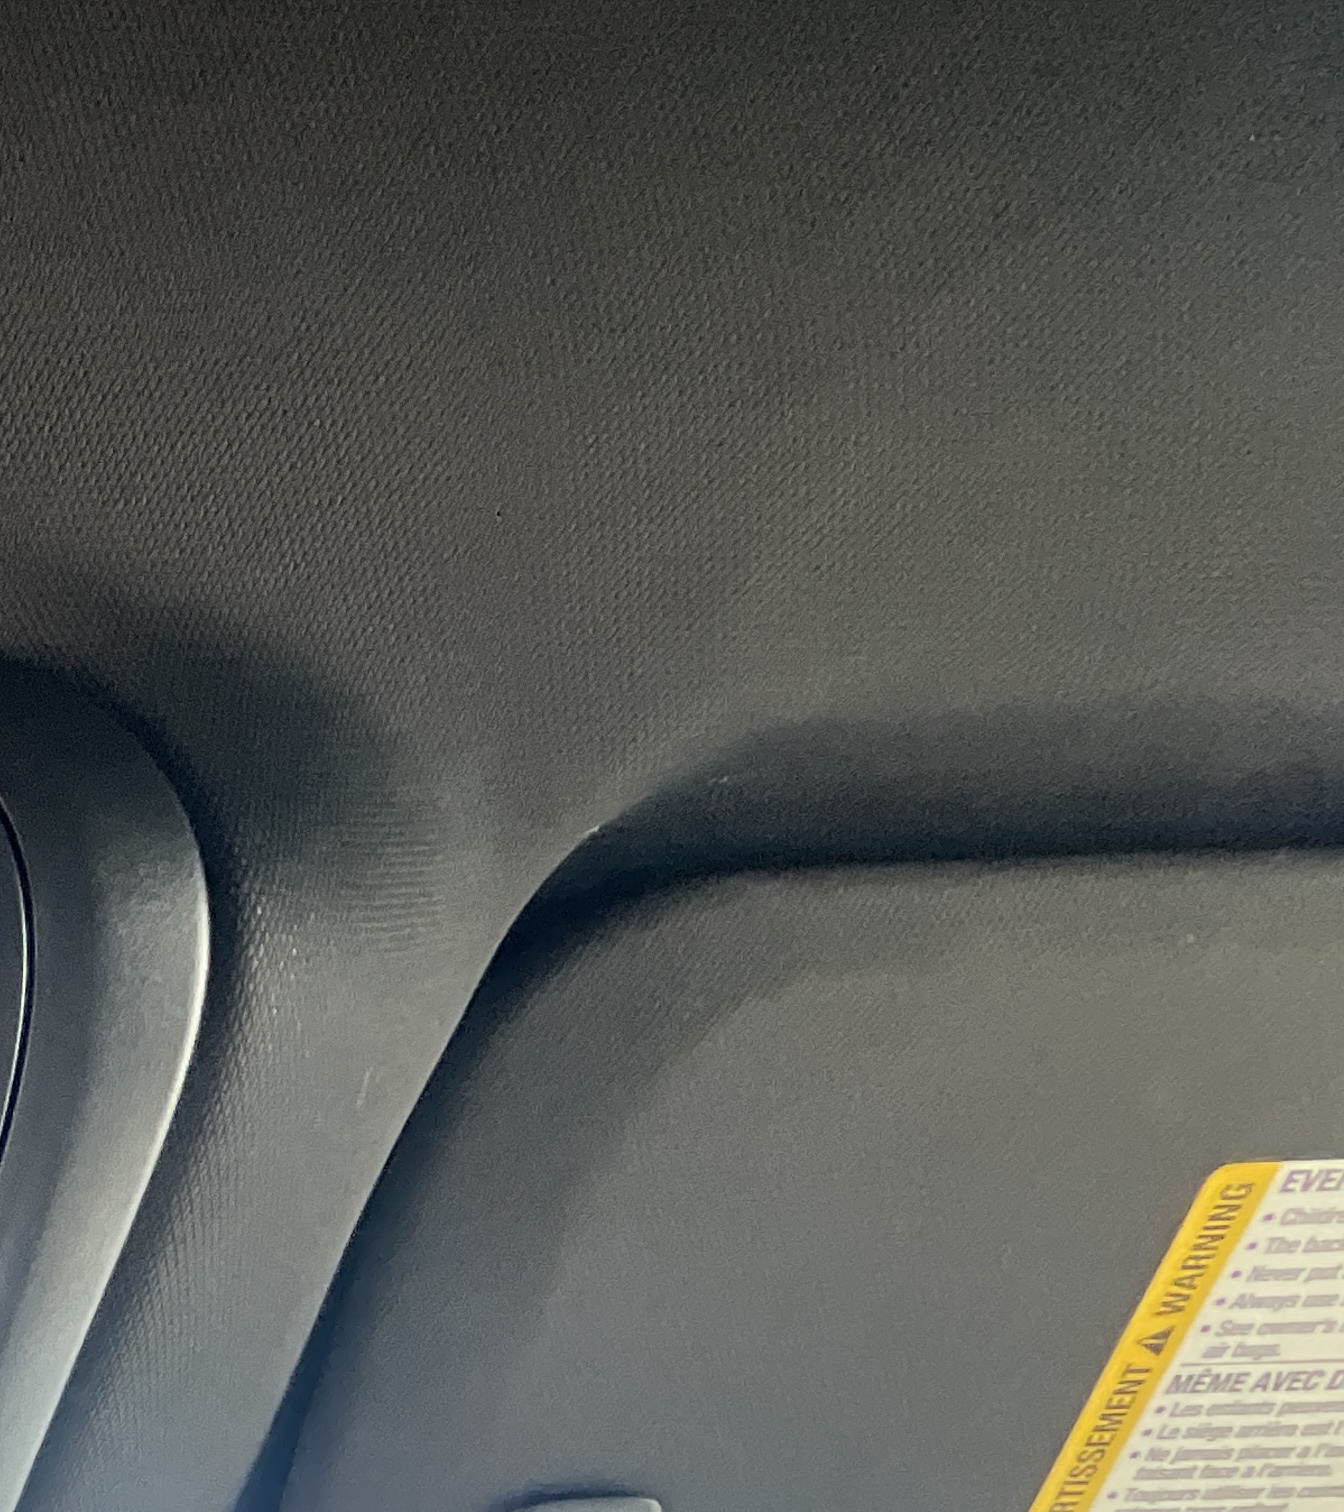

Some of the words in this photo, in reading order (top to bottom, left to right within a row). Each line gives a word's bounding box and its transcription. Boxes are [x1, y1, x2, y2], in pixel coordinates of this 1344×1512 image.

[1280, 1169, 1344, 1193] EVE
[1155, 1182, 1255, 1317] WARNING
[1166, 1368, 1251, 1394] MÊME
[1250, 1370, 1326, 1393] AVEC
